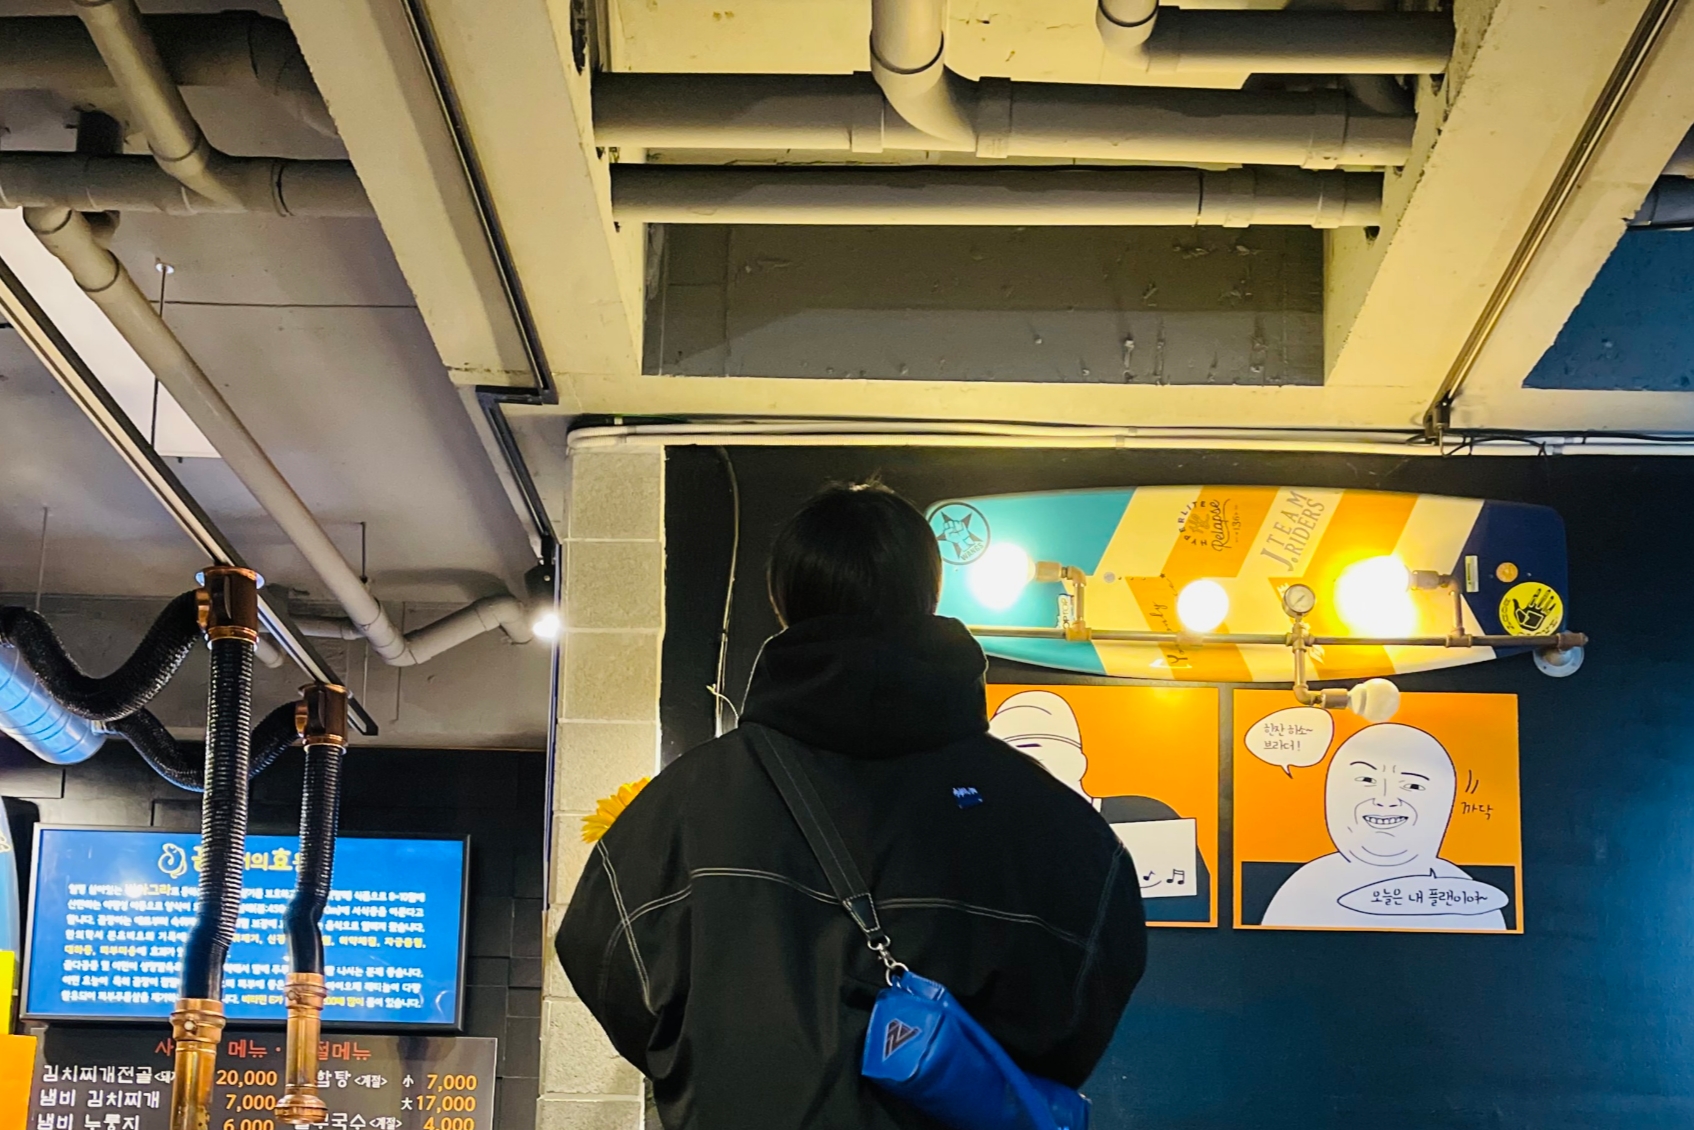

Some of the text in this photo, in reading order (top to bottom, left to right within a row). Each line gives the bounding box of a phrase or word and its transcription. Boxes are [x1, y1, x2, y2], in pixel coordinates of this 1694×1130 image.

[1209, 498, 1233, 552] Relapse
[1266, 491, 1308, 547] TEAM
[1370, 888, 1403, 906] 오늘은
[1408, 889, 1423, 904] 내
[228, 1039, 268, 1059] 메뉴
[42, 1064, 153, 1085] 김치찌개전골
[215, 1069, 278, 1088] 20,000
[316, 1070, 352, 1089] 합탕
[426, 1074, 477, 1092] 7,000
[39, 1088, 277, 1113] 냄비 김치찌개 7,000
[400, 1095, 476, 1114] 大 17,000
